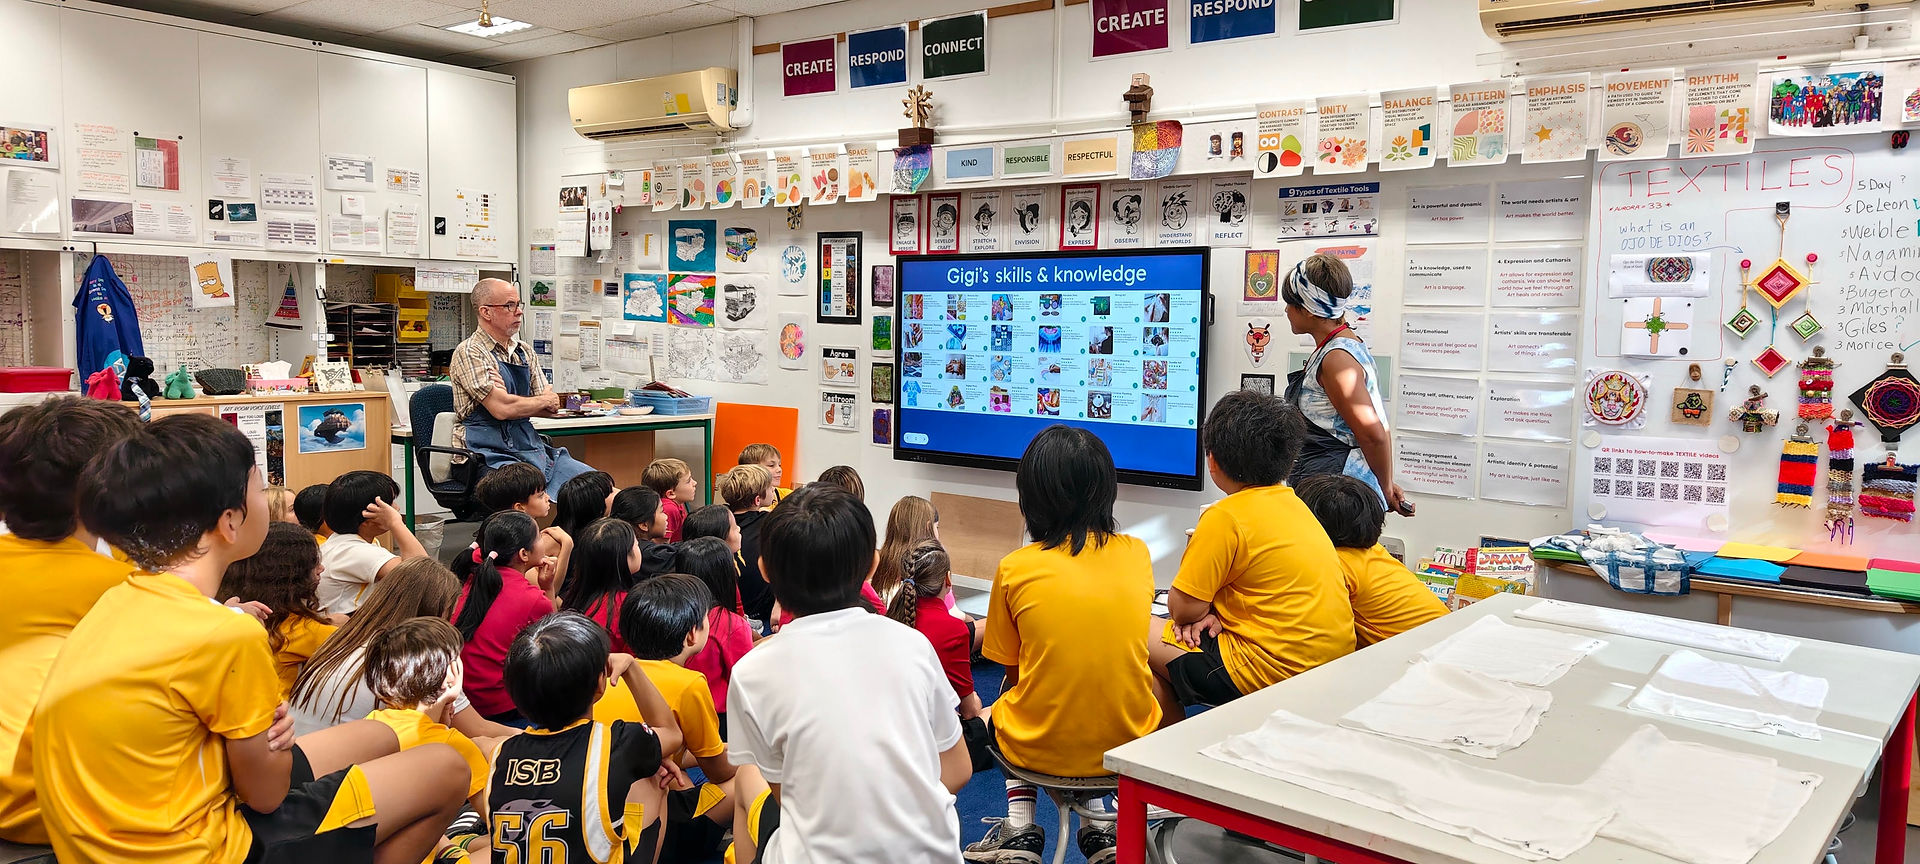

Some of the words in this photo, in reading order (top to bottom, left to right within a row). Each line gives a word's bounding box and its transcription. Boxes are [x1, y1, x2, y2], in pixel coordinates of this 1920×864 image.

[1097, 8, 1165, 33] CREATE
[924, 36, 983, 57] CONNECT
[850, 49, 905, 67] RESPOND
[786, 58, 833, 77] CREATE
[1608, 79, 1670, 92] MOVEMENT
[1689, 73, 1738, 85] RHYTHM
[1454, 90, 1505, 103] PATTERN
[1529, 84, 1586, 97] EMPHASIS
[1384, 96, 1432, 109] BALANCE
[1260, 108, 1303, 119] CONTRAST
[1320, 104, 1347, 115] UNITY
[1006, 154, 1048, 164] RESPONSIBLE
[1068, 151, 1114, 161] RESPECTFUL
[712, 160, 729, 168] COLOR
[1618, 155, 1843, 197] TEXTILES
[1289, 188, 1296, 197] 9
[1296, 189, 1315, 197] Types
[1325, 186, 1350, 194] Textile
[1858, 180, 1866, 190] 5
[1870, 179, 1891, 194] Day
[1648, 202, 1663, 210] 33
[1845, 204, 1852, 213] 5
[1620, 220, 1651, 234] what
[1660, 222, 1671, 231] is
[1680, 221, 1695, 231] an
[1850, 218, 1909, 239] Weible
[1650, 236, 1664, 248] DE
[1668, 232, 1712, 247] DIOS?
[1847, 243, 1920, 268] Nagami
[947, 267, 990, 287] Gigi's
[995, 266, 1032, 284] skills
[1037, 267, 1049, 284] &
[1054, 265, 1147, 287] knowledge
[1846, 284, 1914, 304] Bugera
[1838, 306, 1845, 314] 3
[1851, 298, 1919, 316] Marshall
[1838, 322, 1844, 332] 3
[1845, 316, 1887, 338] Giles
[1835, 341, 1843, 350] 3
[830, 349, 849, 358] Agree
[823, 392, 855, 403] Restroom
[1480, 554, 1525, 565] DRAW
[1430, 586, 1447, 594] TRIC
[504, 758, 561, 786] ISB
[493, 809, 569, 864] 56
